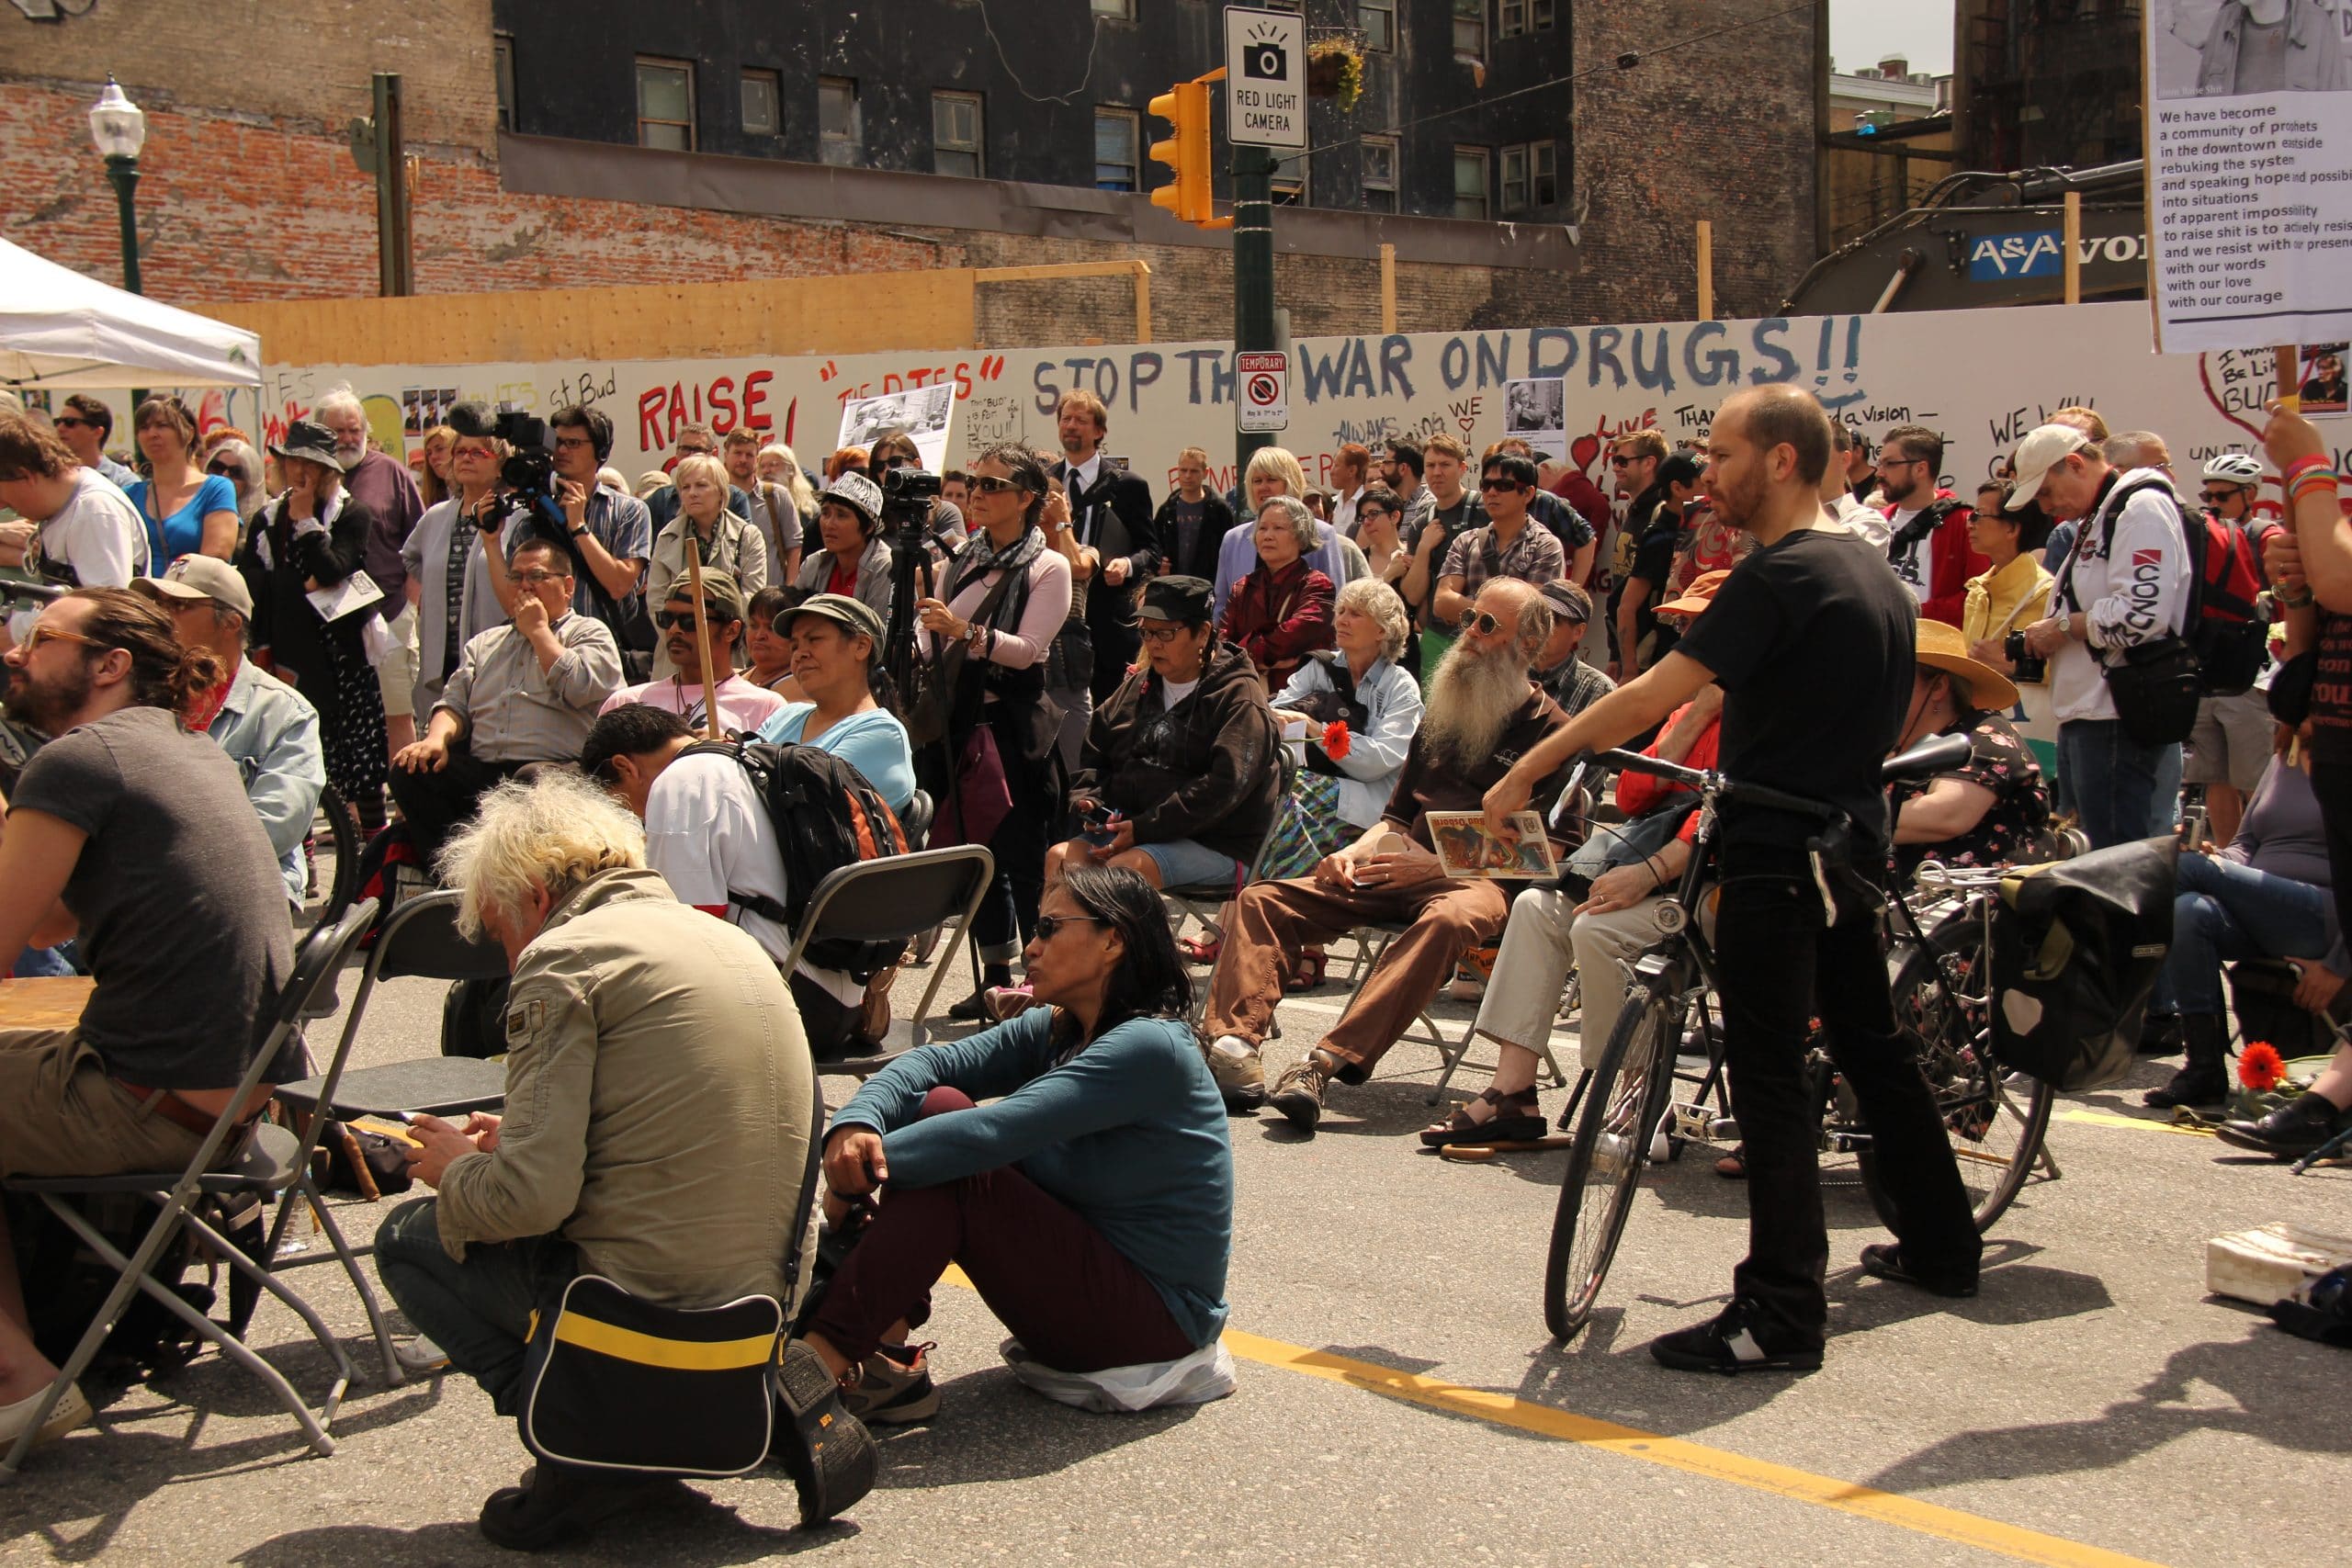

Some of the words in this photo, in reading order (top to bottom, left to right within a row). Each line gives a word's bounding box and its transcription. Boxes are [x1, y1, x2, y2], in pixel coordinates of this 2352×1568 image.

[1237, 90, 1260, 107] RED
[1266, 93, 1297, 110] LIGHT
[1245, 112, 1290, 131] CAMERA
[2159, 112, 2180, 123] We
[2185, 110, 2215, 122] have
[2220, 106, 2277, 119] become
[2160, 131, 2167, 141] a
[2172, 124, 2245, 140] community
[2249, 121, 2266, 135] of
[2161, 146, 2173, 157] in
[2177, 144, 2198, 156] the
[2202, 140, 2277, 154] downtown
[2161, 160, 2219, 175] rebuking
[2223, 159, 2245, 170] the
[2162, 179, 2186, 191] and
[2189, 175, 2249, 191] speaking
[2255, 173, 2290, 186] hope
[2162, 196, 2188, 208] into
[2191, 192, 2258, 206] situations
[2163, 212, 2177, 224] of
[2179, 209, 2238, 225] apparent
[2164, 231, 2177, 241] to
[2181, 228, 2212, 240] raise
[2217, 226, 2241, 238] shit
[2245, 225, 2257, 236] is
[2263, 223, 2278, 234] to
[1971, 234, 2059, 275] A&A
[2165, 246, 2188, 258] and
[2193, 246, 2211, 256] we
[2216, 243, 2252, 255] resist
[2257, 238, 2290, 252] with
[2166, 263, 2194, 275] with
[2199, 263, 2220, 273] our
[2224, 258, 2266, 271] words
[2167, 279, 2195, 291] with
[2199, 279, 2221, 290] our
[2224, 276, 2251, 288] love
[2168, 296, 2196, 308] with
[2200, 296, 2222, 306] our
[2225, 291, 2282, 305] courage
[1033, 351, 1163, 415] STOP
[1174, 349, 1237, 405] TH
[1298, 333, 1416, 404] WAR
[1440, 330, 1510, 391] ON
[1241, 356, 1283, 370] TEMPORARY
[579, 367, 616, 406] Bud
[639, 369, 774, 451] RAISE
[1448, 396, 1483, 418] WE
[1674, 404, 1715, 427] THA
[1596, 407, 1657, 440] LIVE
[1989, 407, 2030, 447] WE
